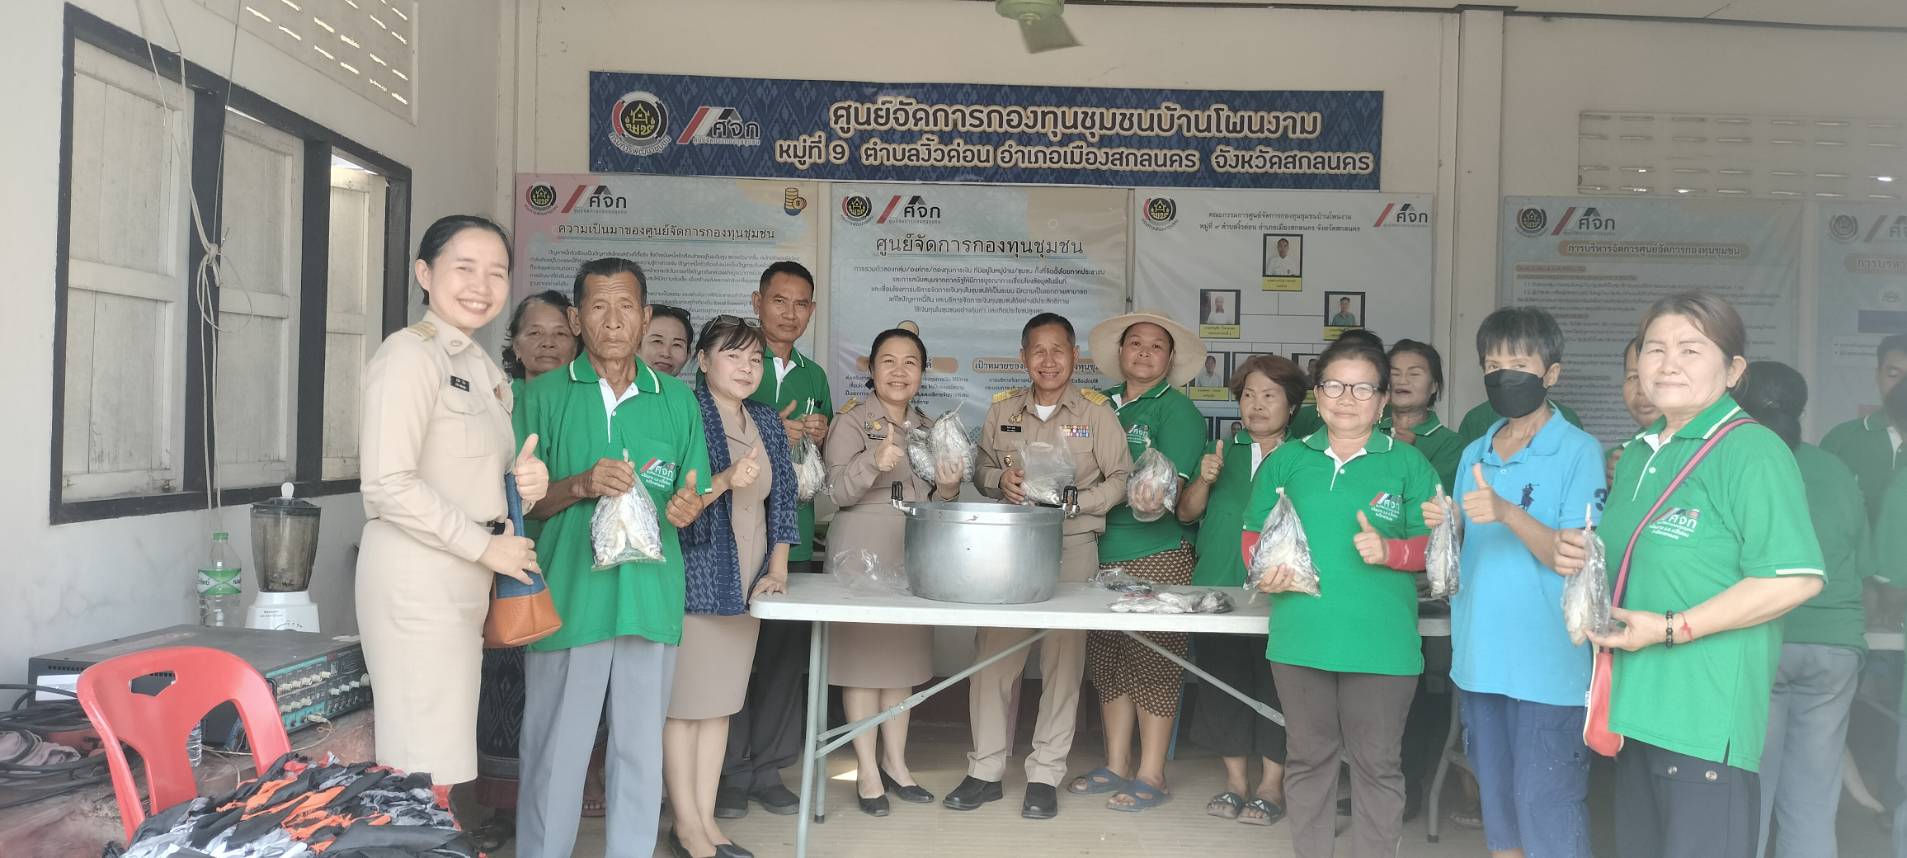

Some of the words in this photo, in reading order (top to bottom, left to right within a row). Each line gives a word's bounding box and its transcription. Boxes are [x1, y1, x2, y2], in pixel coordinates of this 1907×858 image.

[832, 99, 1319, 138] ศูนย์จัดการกองทุนชุมชนบ้านโพนงาม
[712, 120, 761, 138] ศจก
[778, 134, 823, 166] หมู่ที่
[831, 143, 846, 161] 9
[1000, 141, 1197, 169] อำเภอเมืองสกลนคร
[1214, 145, 1371, 171] จังหวัดสกลนคร
[589, 192, 627, 209] ศจก
[903, 203, 941, 219] ศจก
[1396, 209, 1428, 224] ศจก
[558, 222, 775, 241] ความเป็นมาของศูนย์จัดการกองทุนชุมชน
[1578, 217, 1616, 230] ศจก
[875, 232, 1084, 258] ศูนย์จัดการกองทุนชุมชน
